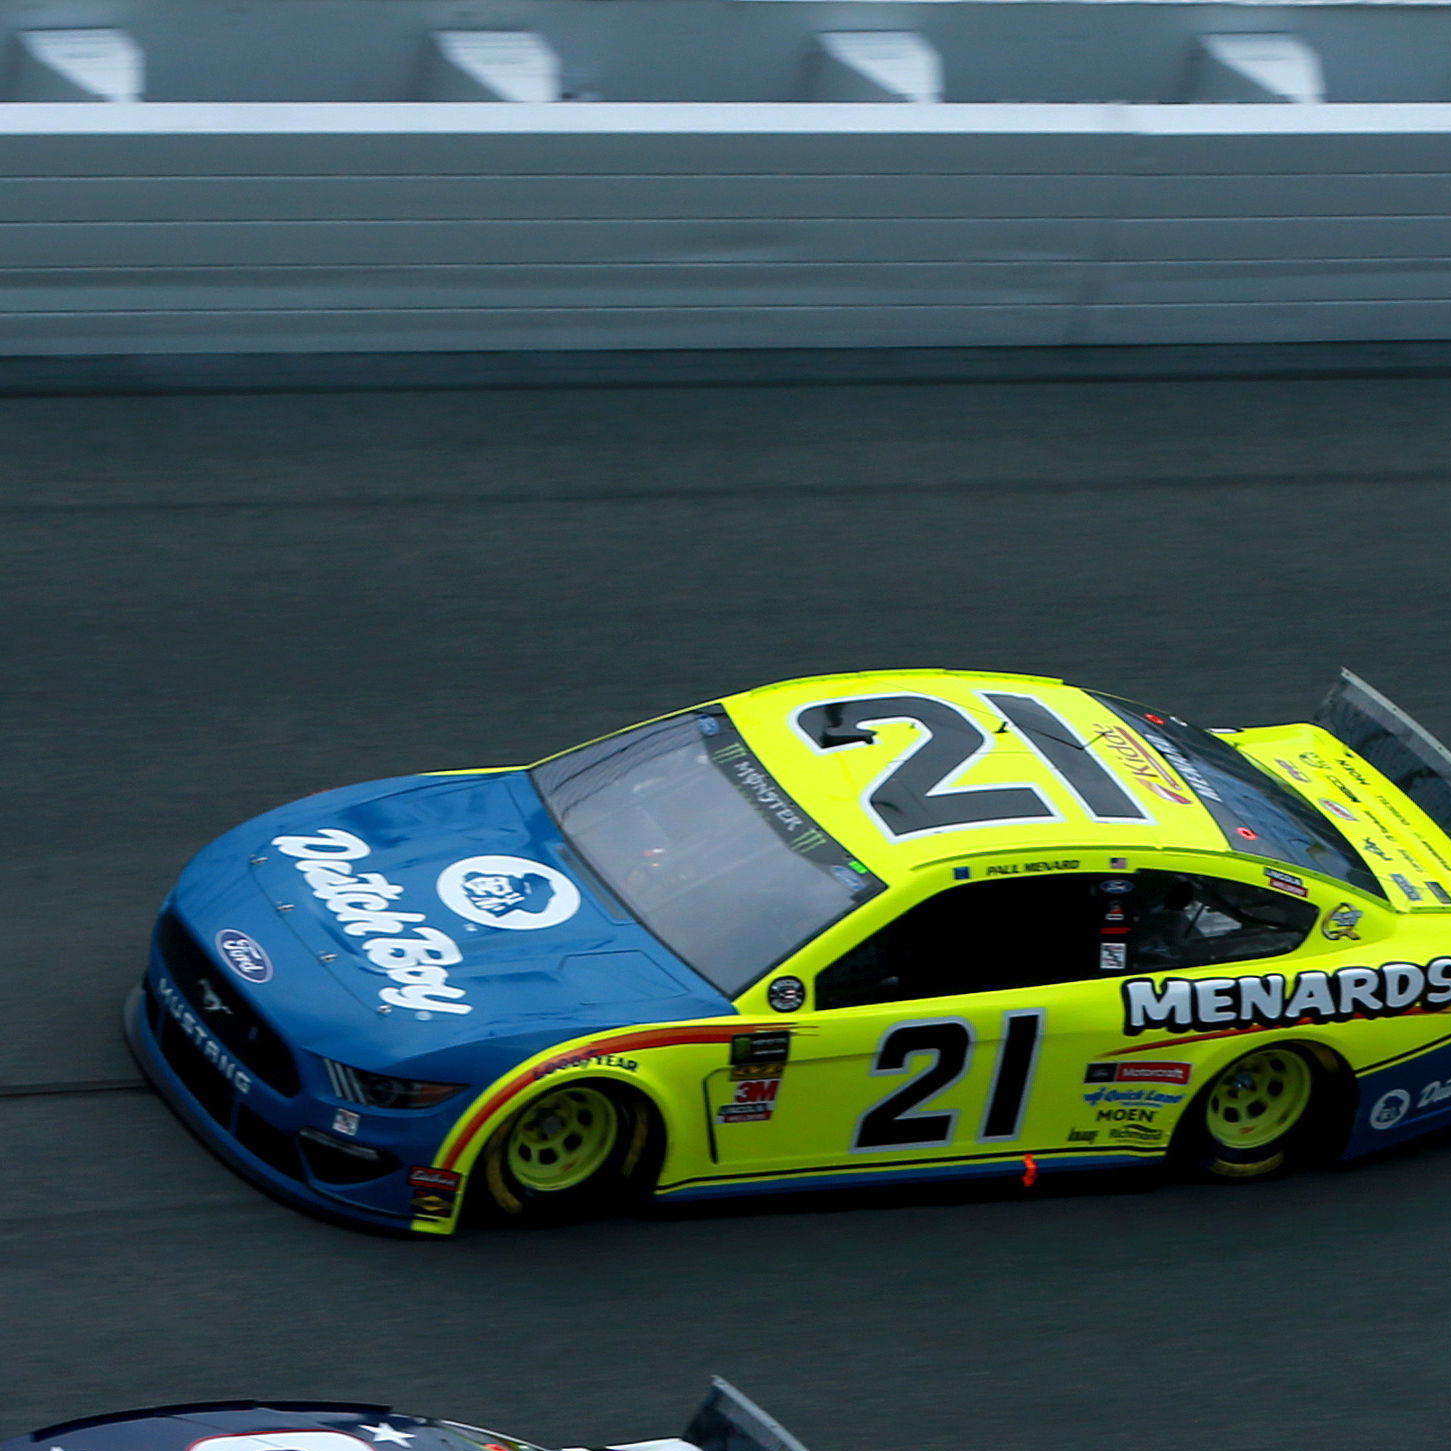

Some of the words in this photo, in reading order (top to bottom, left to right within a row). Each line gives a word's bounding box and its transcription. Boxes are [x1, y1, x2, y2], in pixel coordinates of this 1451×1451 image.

[788, 688, 1157, 842] 21
[223, 937, 265, 976] Ford
[361, 927, 474, 1015] Boy
[158, 977, 253, 1095] MUSTANG
[735, 1081, 782, 1103] 3M
[851, 1009, 1048, 1153] 21
[1095, 1109, 1154, 1122] MOEN
